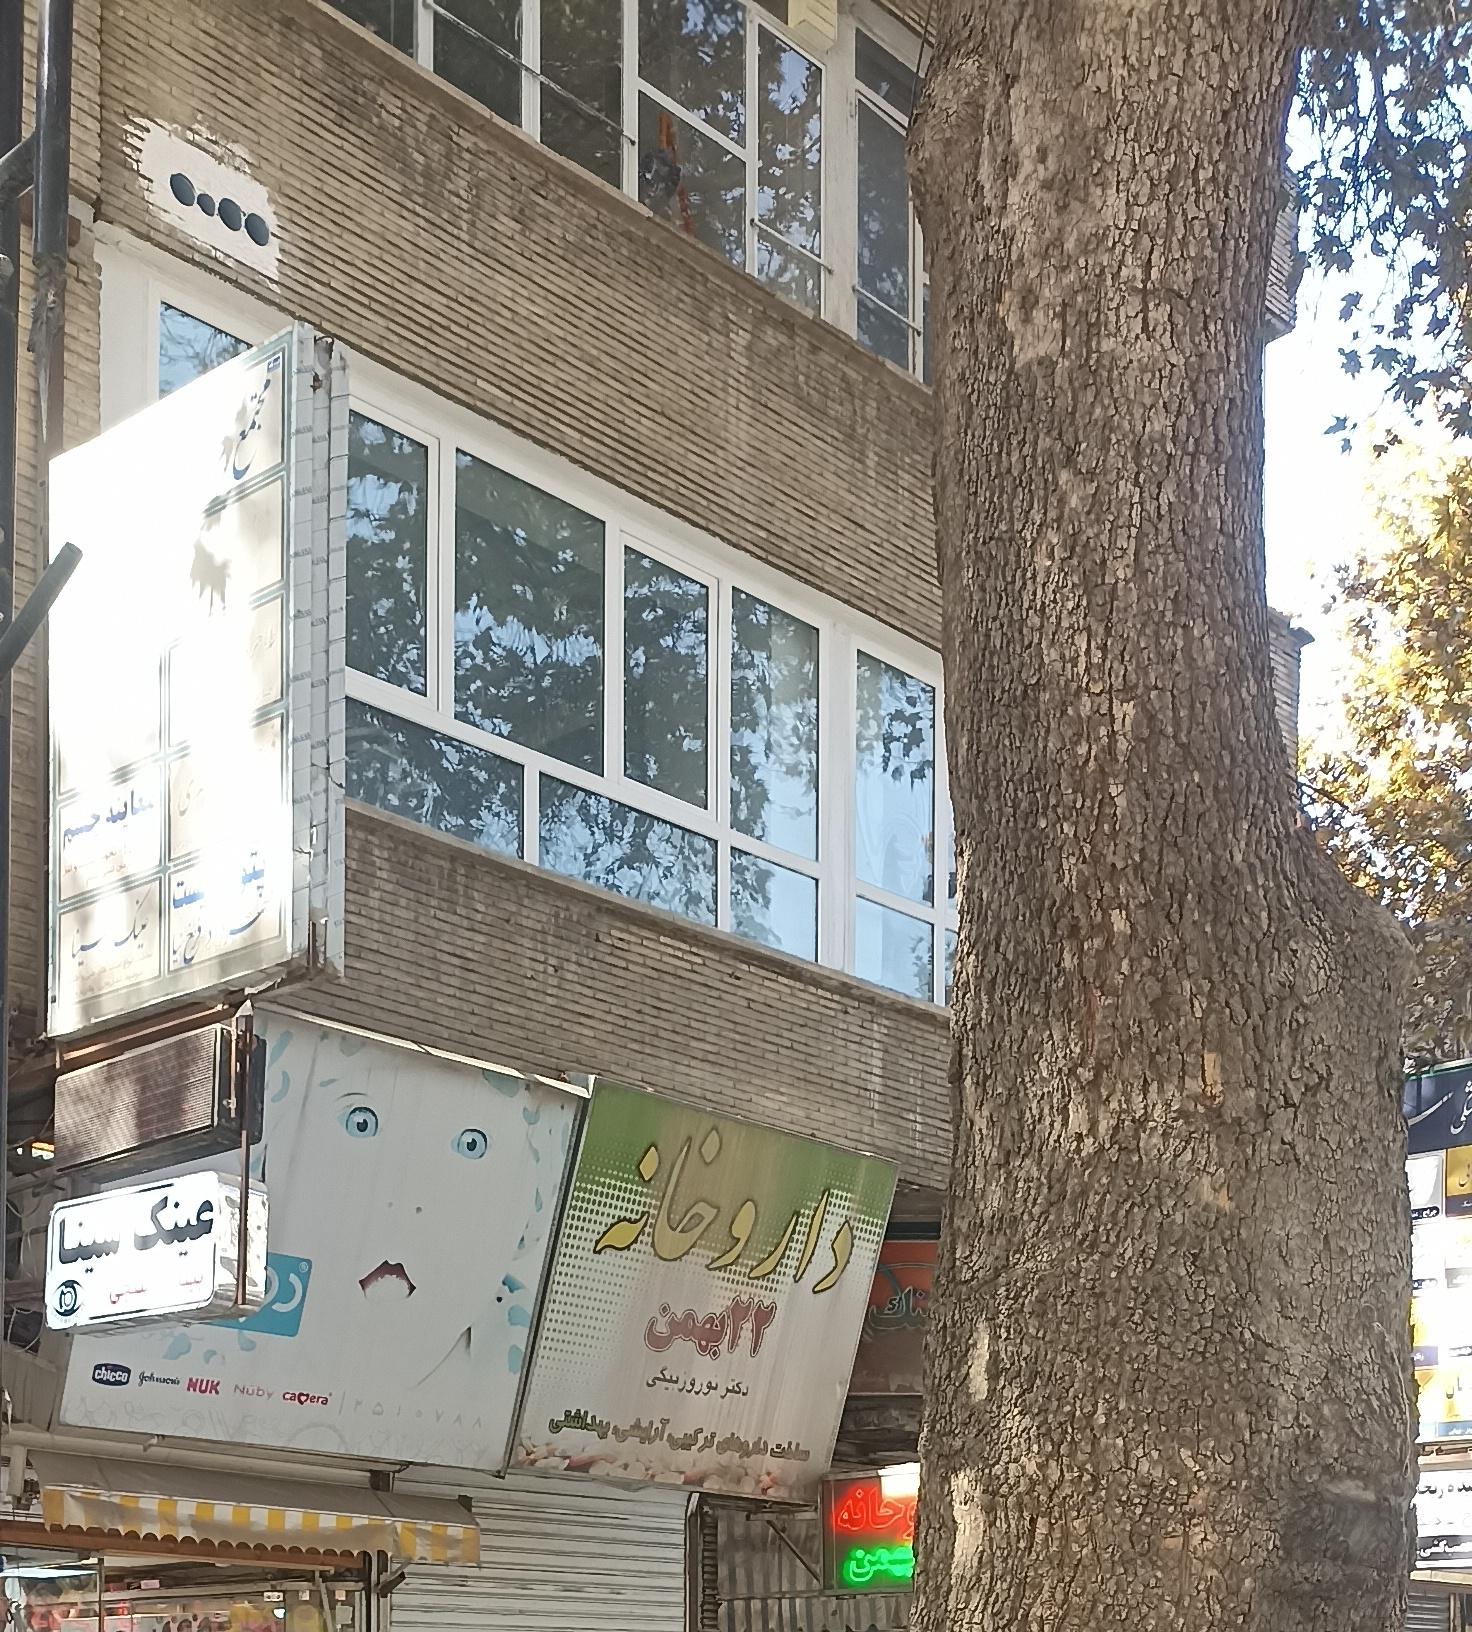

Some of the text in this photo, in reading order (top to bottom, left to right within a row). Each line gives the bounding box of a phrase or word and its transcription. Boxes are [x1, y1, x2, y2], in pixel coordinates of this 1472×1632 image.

[595, 1126, 854, 1294] داروخانه
[59, 1196, 214, 1273] عینک سینا
[94, 1366, 129, 1383] chicco
[186, 1377, 221, 1395] NUK
[233, 1384, 274, 1400] Nuby
[720, 1378, 749, 1399] دکتر
[548, 1408, 611, 1440] بهداشتی
